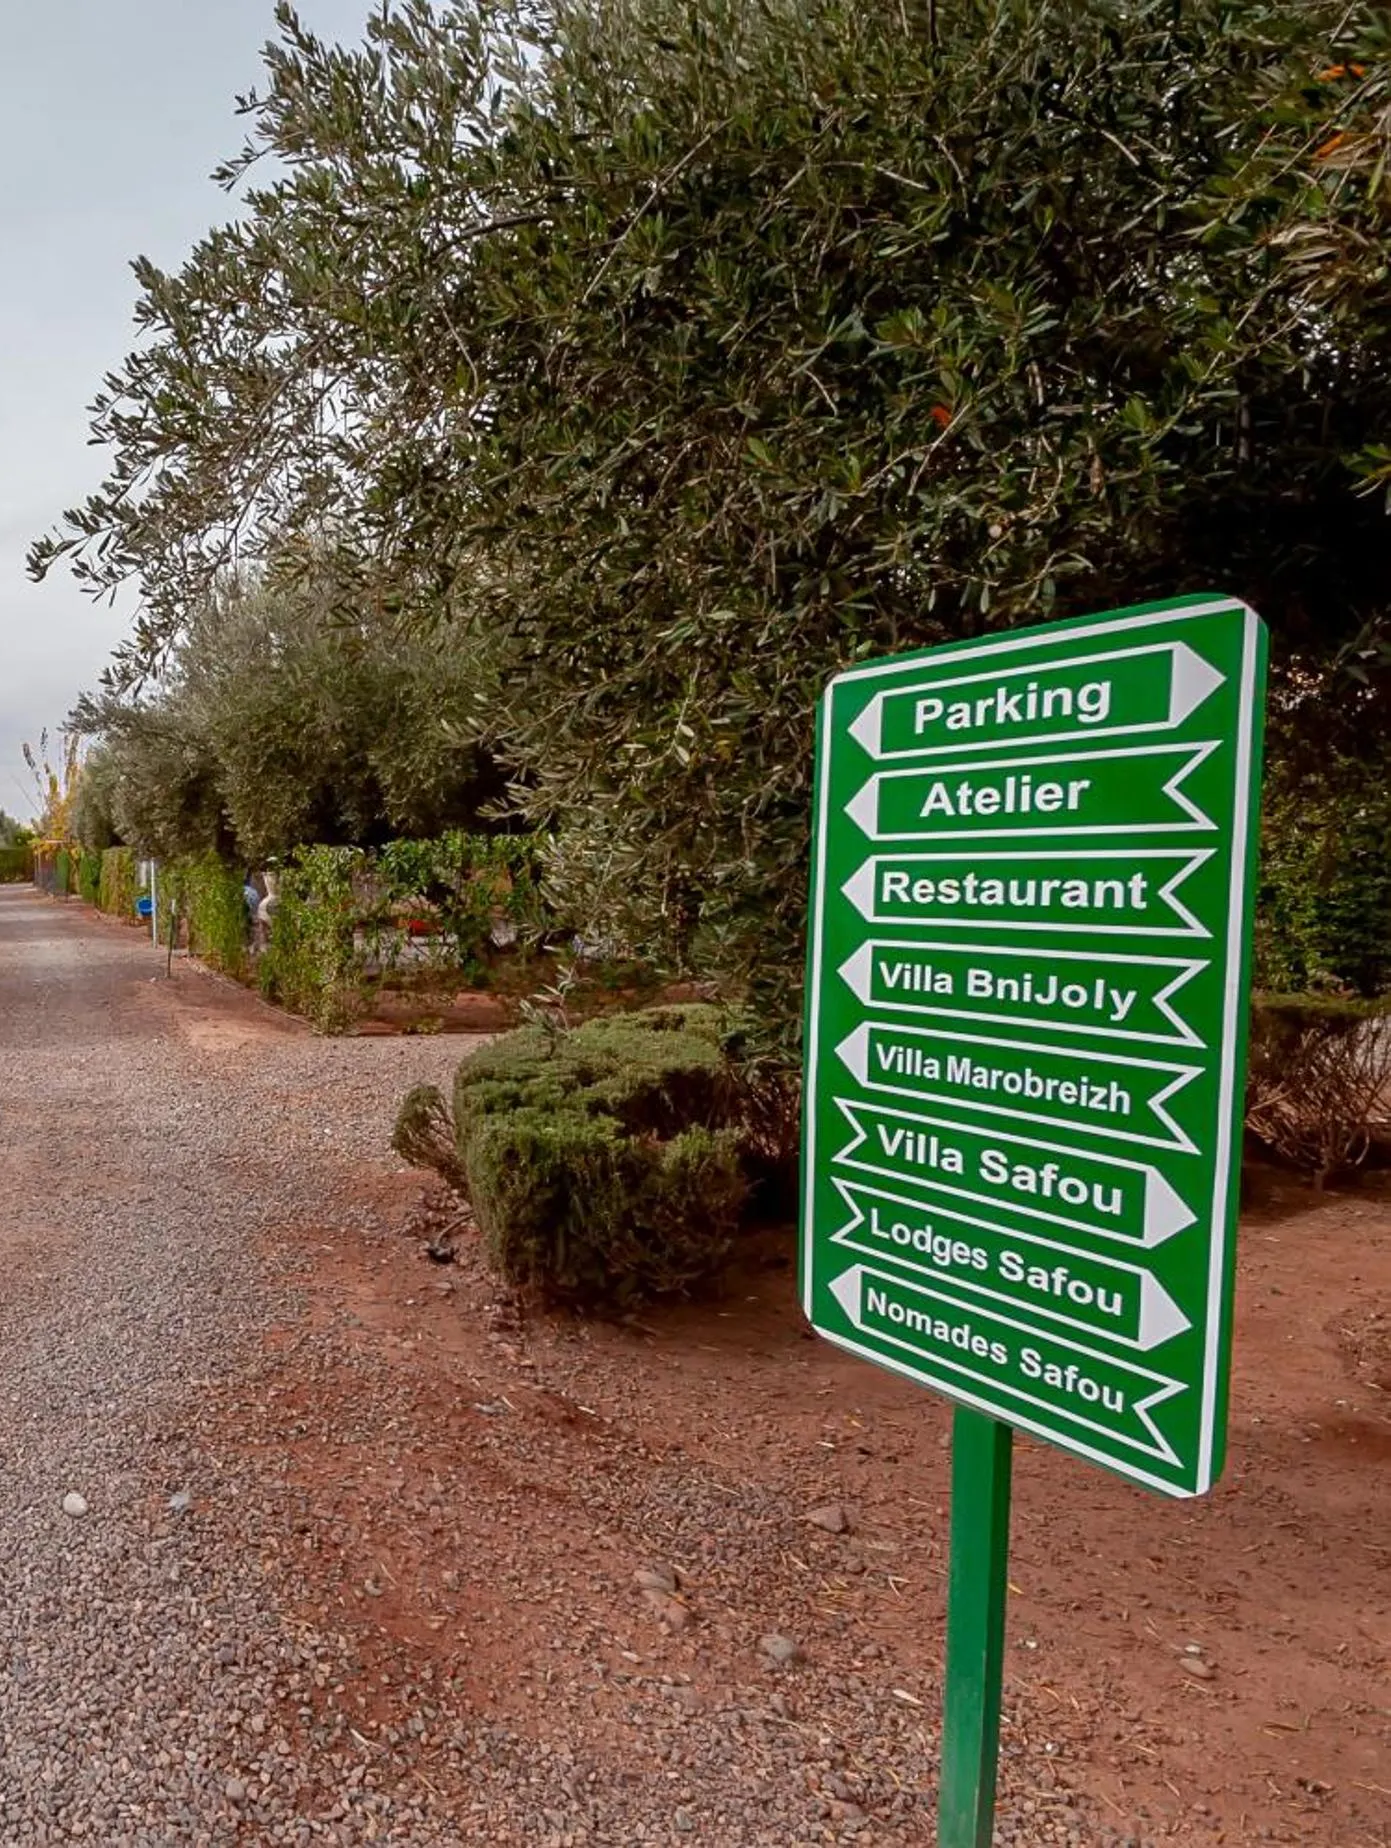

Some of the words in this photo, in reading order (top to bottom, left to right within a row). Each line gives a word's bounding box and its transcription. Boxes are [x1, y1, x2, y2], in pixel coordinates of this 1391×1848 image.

[915, 680, 1111, 734] Parking
[919, 775, 1091, 817] Atelier
[882, 871, 1147, 909] Restaurant
[879, 961, 953, 994] Villa
[967, 968, 1137, 1021] BniJoly
[876, 1042, 940, 1080] Villa
[946, 1055, 1130, 1114] Marobreizh
[877, 1123, 963, 1174] Villa
[979, 1149, 1122, 1215] Safou
[871, 1208, 988, 1270] Lodges
[998, 1250, 1122, 1316] Safou
[867, 1287, 1008, 1365] Nomades
[1019, 1348, 1123, 1413] Safou
